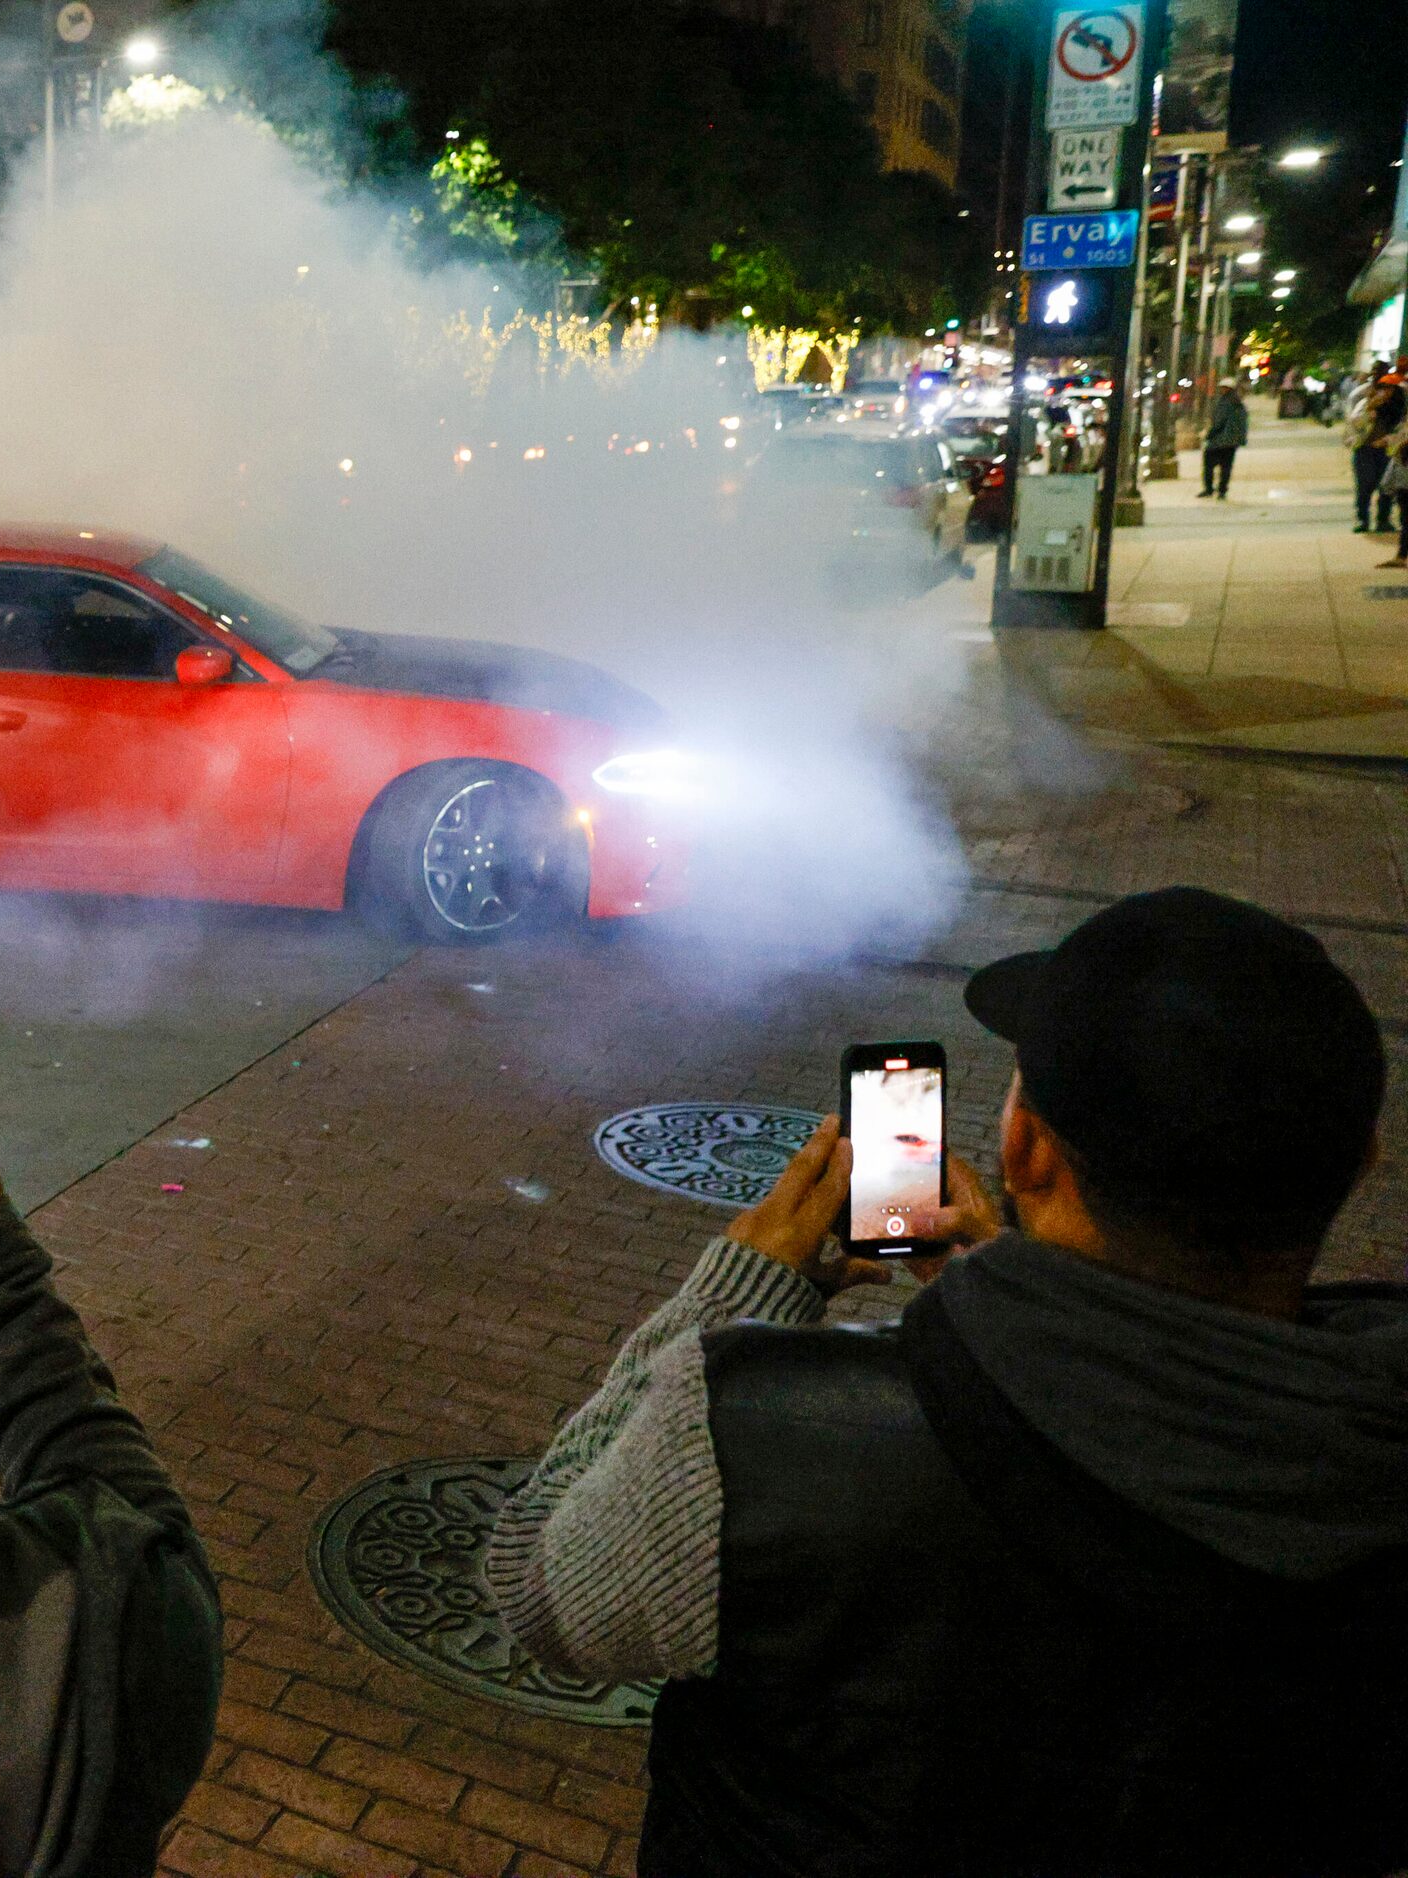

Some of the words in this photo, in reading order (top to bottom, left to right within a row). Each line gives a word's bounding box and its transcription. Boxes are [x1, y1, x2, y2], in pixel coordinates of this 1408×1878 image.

[1063, 135, 1110, 155] ONE
[1059, 159, 1110, 177] WAY
[1030, 221, 1128, 246] Ervay
